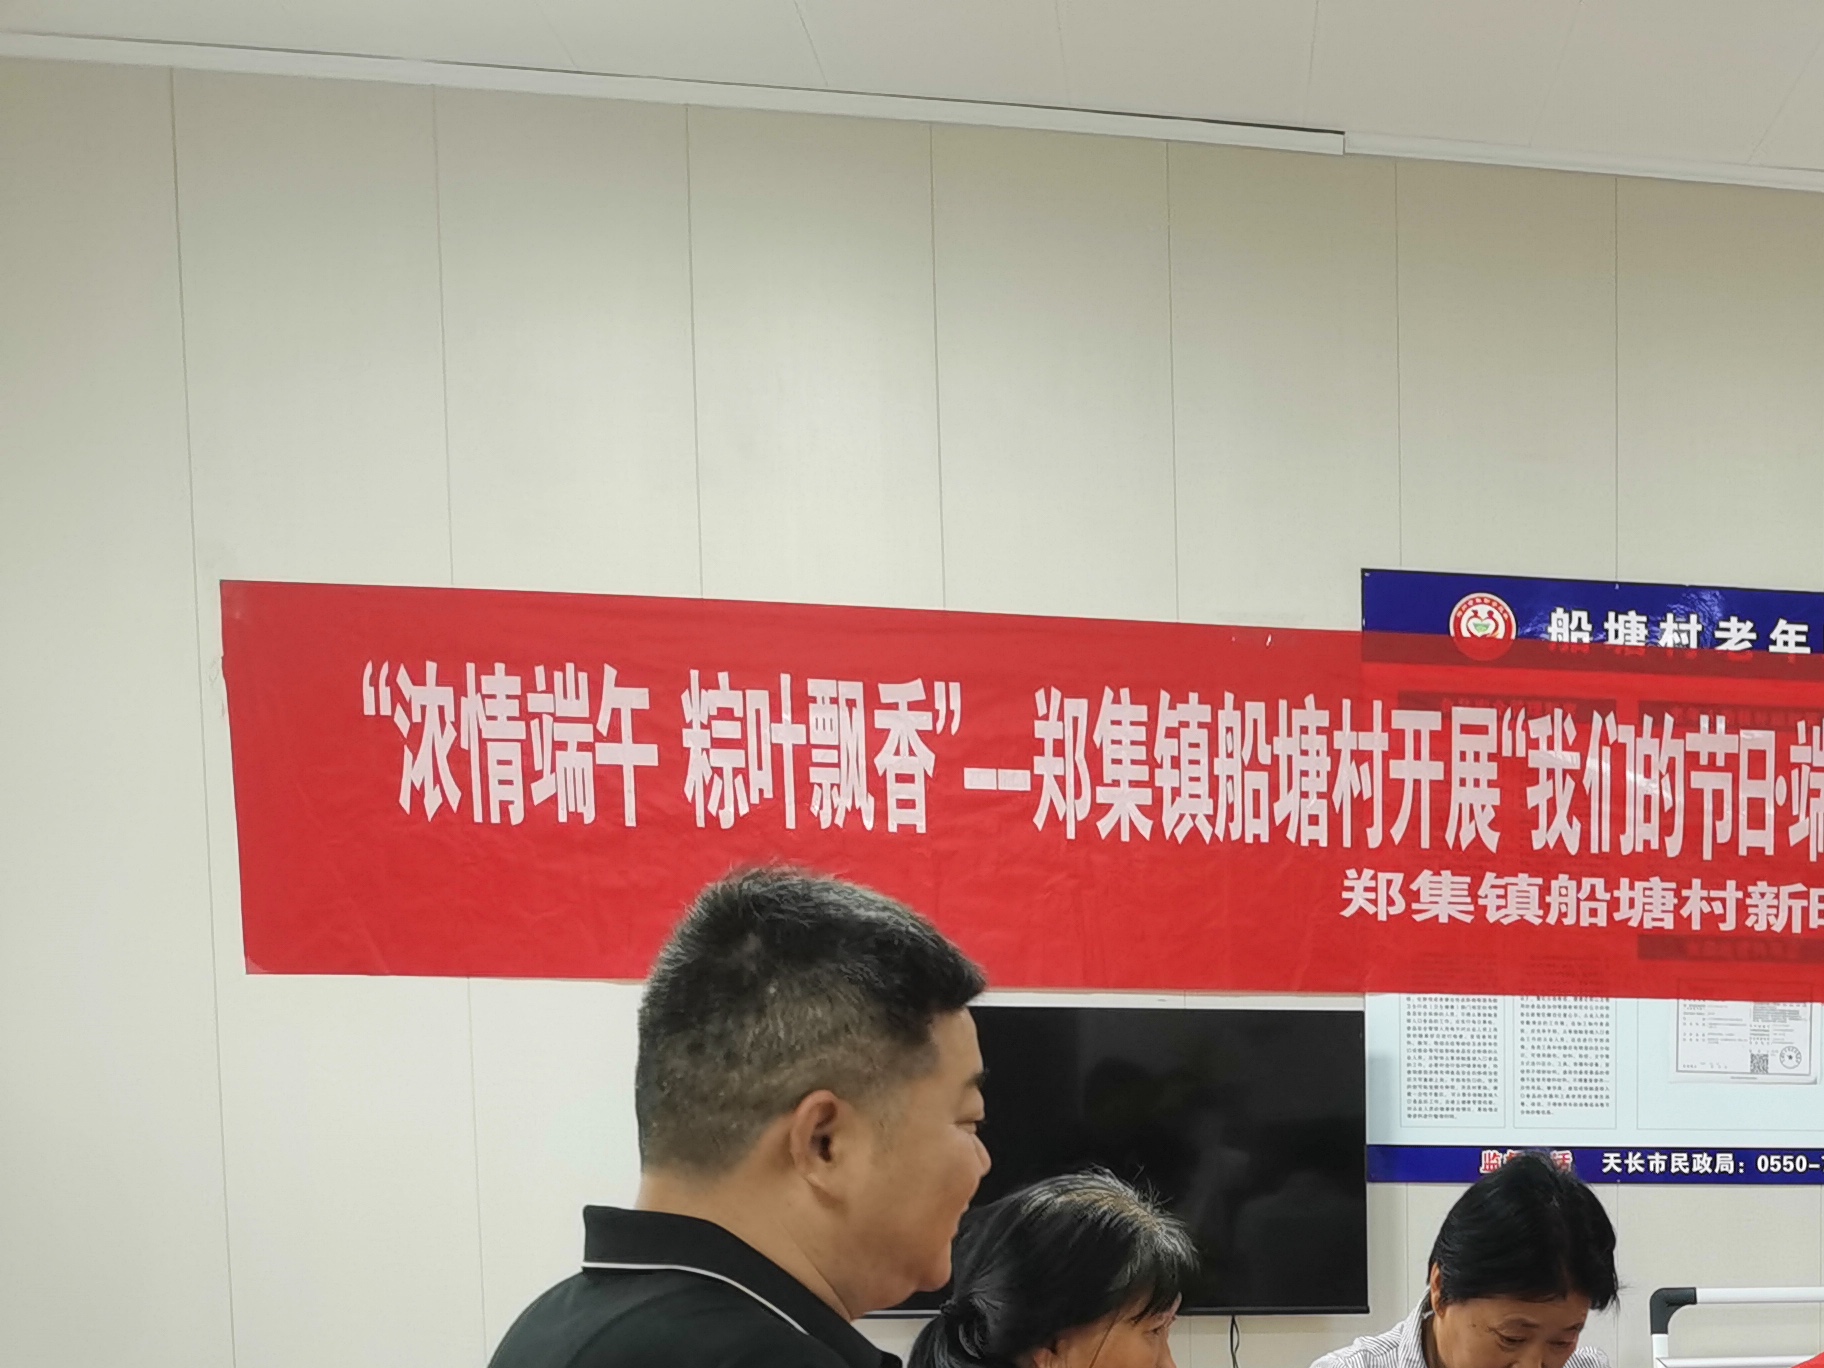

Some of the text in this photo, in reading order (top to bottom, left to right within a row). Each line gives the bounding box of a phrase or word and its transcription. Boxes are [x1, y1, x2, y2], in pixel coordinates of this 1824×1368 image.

[363, 661, 659, 827] “浓情端午
[1480, 1150, 1573, 1174] 监话
